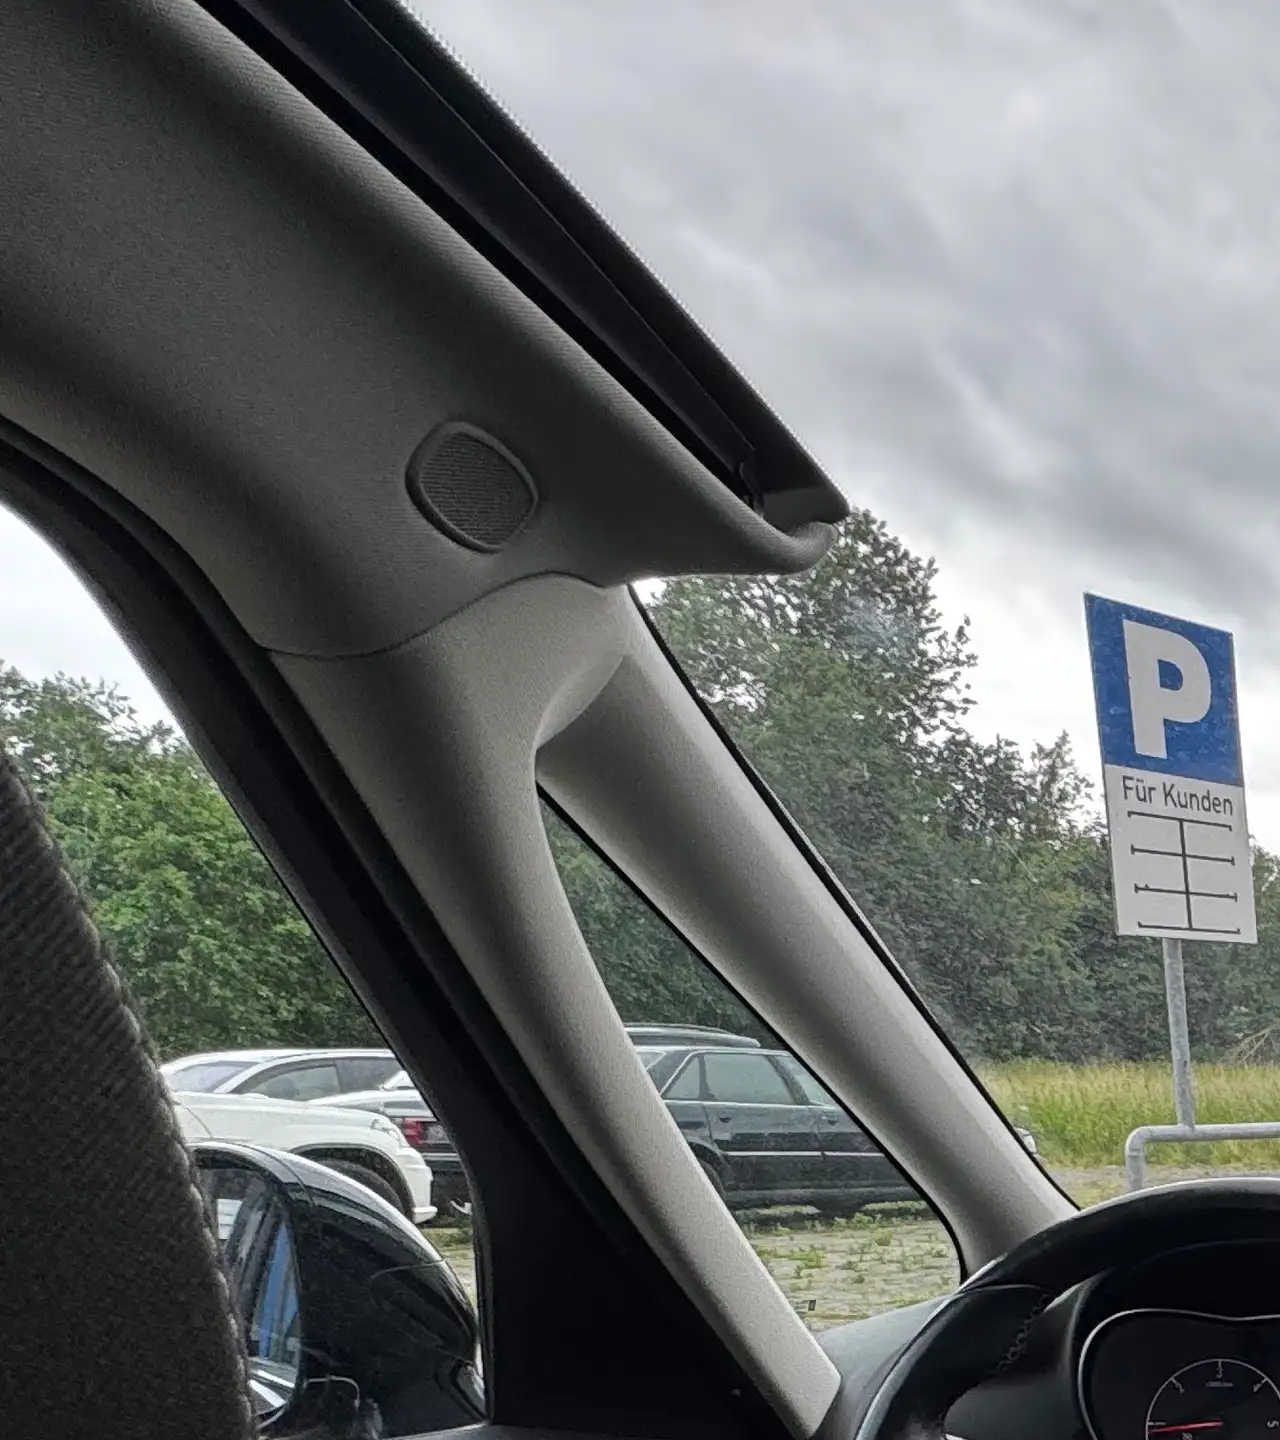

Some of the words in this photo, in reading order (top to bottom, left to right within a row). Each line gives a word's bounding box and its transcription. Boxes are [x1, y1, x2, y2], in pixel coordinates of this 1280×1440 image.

[1122, 618, 1212, 760] P
[1121, 774, 1156, 804] Für
[1162, 782, 1233, 817] Kunden
